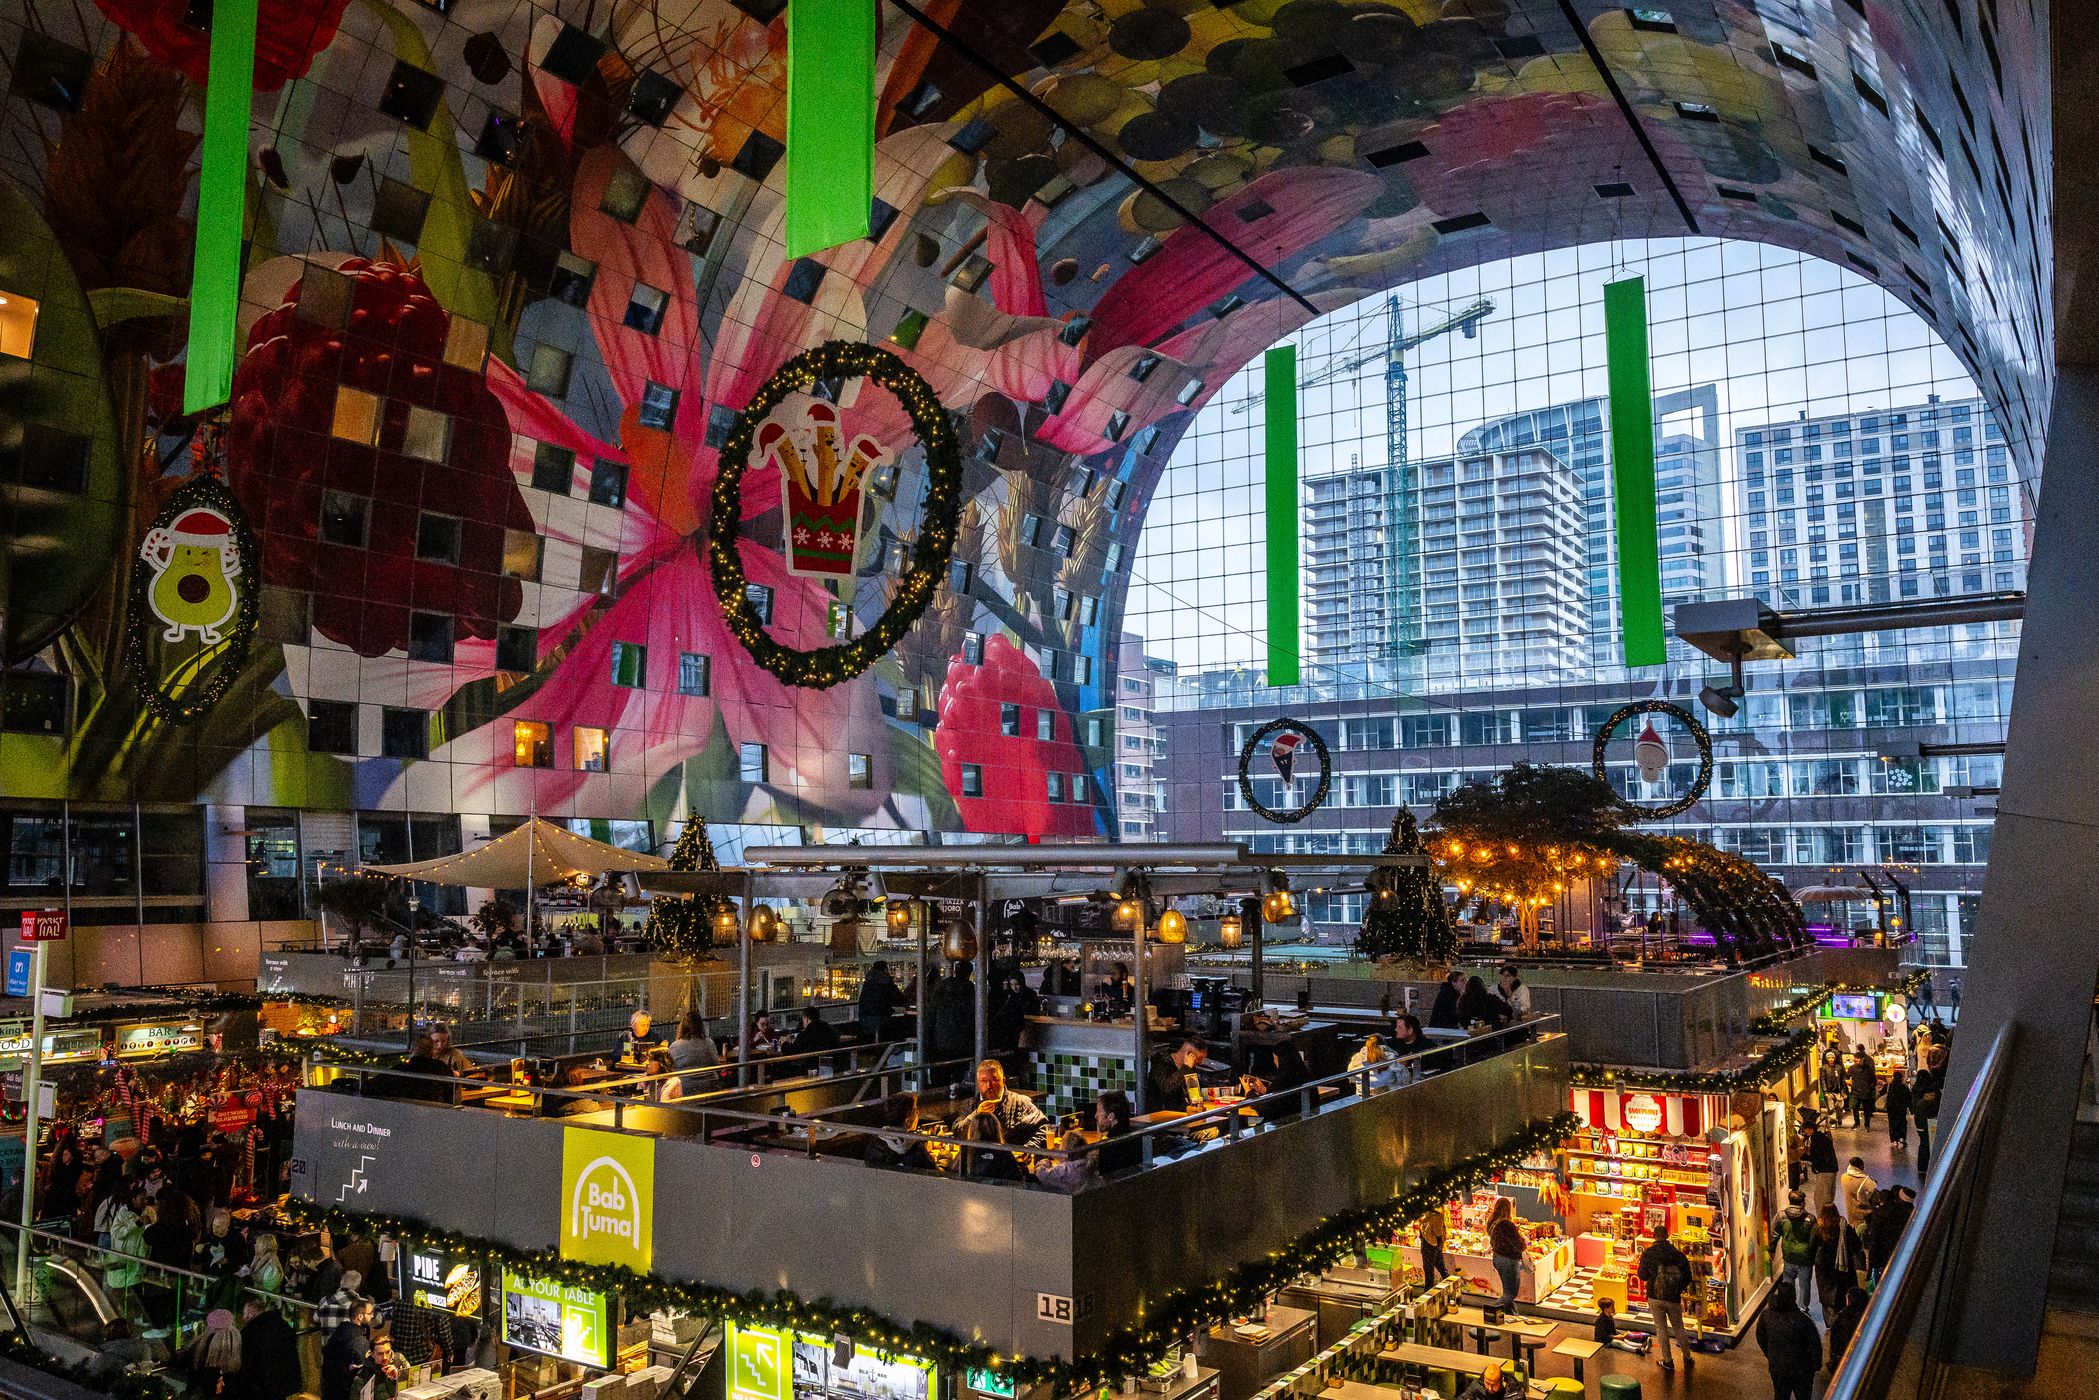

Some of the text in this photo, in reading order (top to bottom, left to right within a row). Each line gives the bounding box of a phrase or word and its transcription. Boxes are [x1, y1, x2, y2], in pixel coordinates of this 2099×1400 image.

[1009, 902, 1020, 910] Bab
[148, 1027, 171, 1037] BAR
[0, 1039, 30, 1050] OOD
[333, 1135, 351, 1149] with
[360, 1136, 381, 1150] view!
[292, 1159, 305, 1174] 20
[589, 1176, 625, 1211] Bab
[581, 1205, 631, 1240] Tuma
[414, 1255, 440, 1281] PIDE
[529, 1279, 560, 1299] YOUR
[1040, 1296, 1071, 1321] 18
